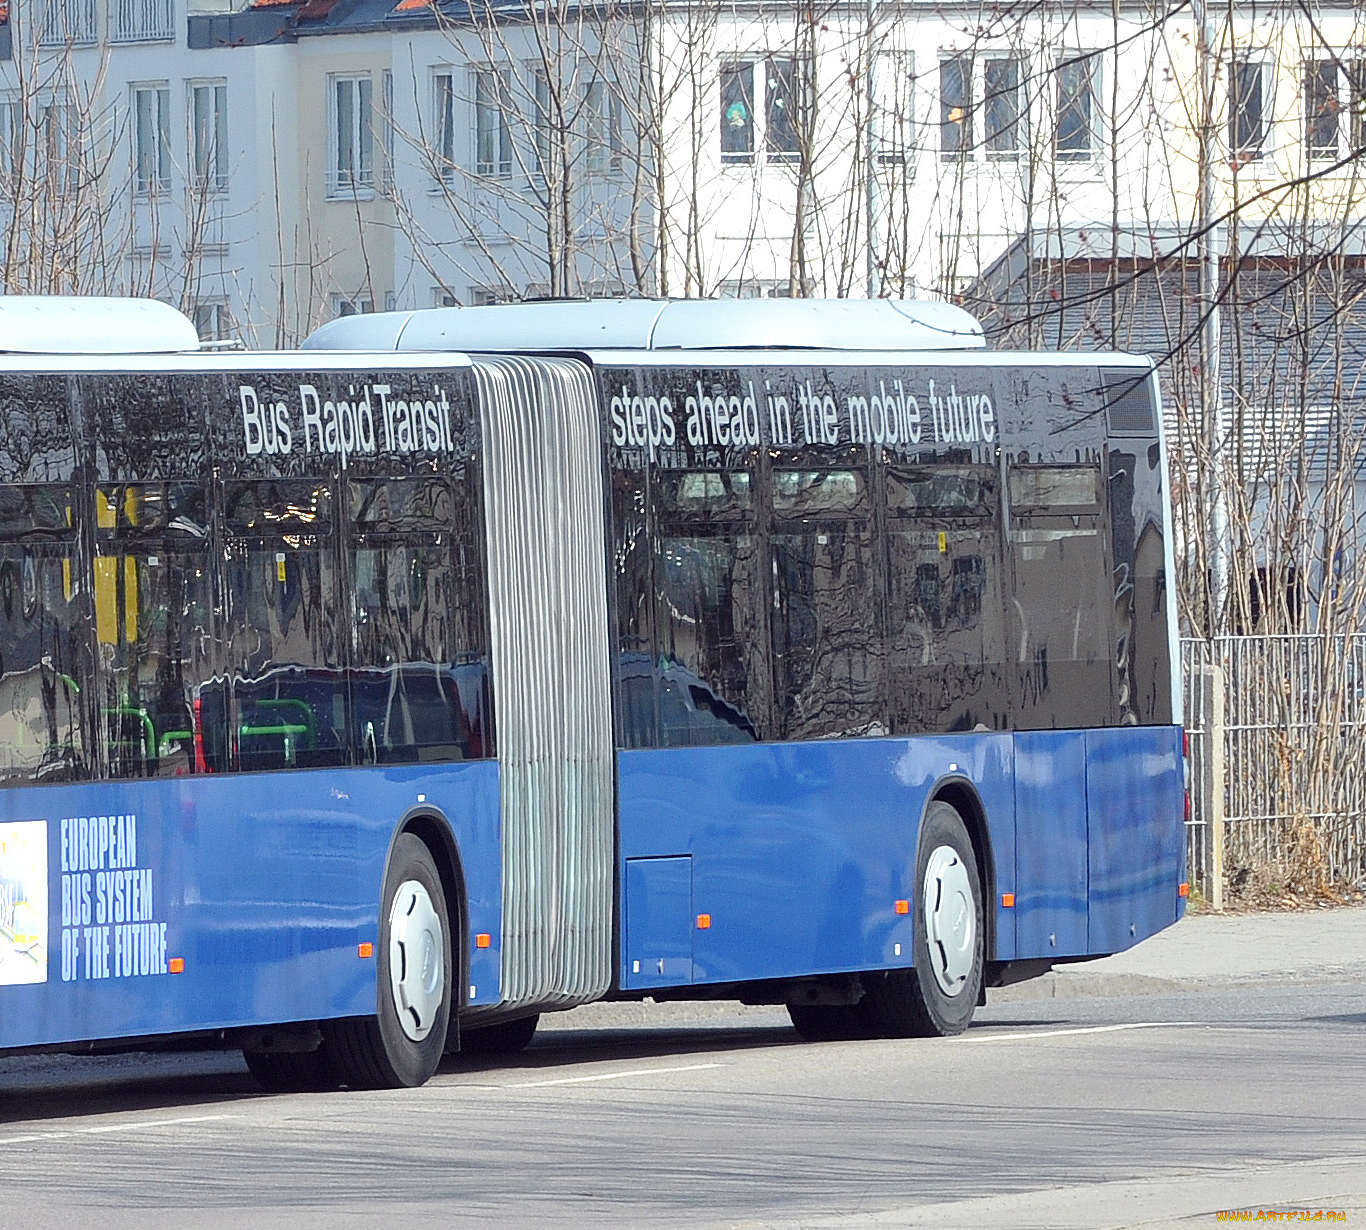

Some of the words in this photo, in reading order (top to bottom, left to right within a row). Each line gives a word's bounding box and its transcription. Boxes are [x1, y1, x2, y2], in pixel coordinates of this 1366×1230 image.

[239, 385, 292, 454] Bus
[299, 384, 375, 470] Rapid
[372, 384, 454, 451] Transit
[610, 384, 676, 463] steps
[685, 380, 760, 446] ahead
[765, 380, 792, 445] in
[798, 379, 838, 444] the
[847, 380, 921, 444] mobile
[928, 378, 995, 443] future
[60, 814, 137, 872] EUROPEAN
[61, 872, 92, 927] BUS
[95, 868, 153, 925] SYSTEM
[61, 928, 80, 982] OF
[84, 926, 110, 980] THE
[114, 922, 168, 978] FUTURE
